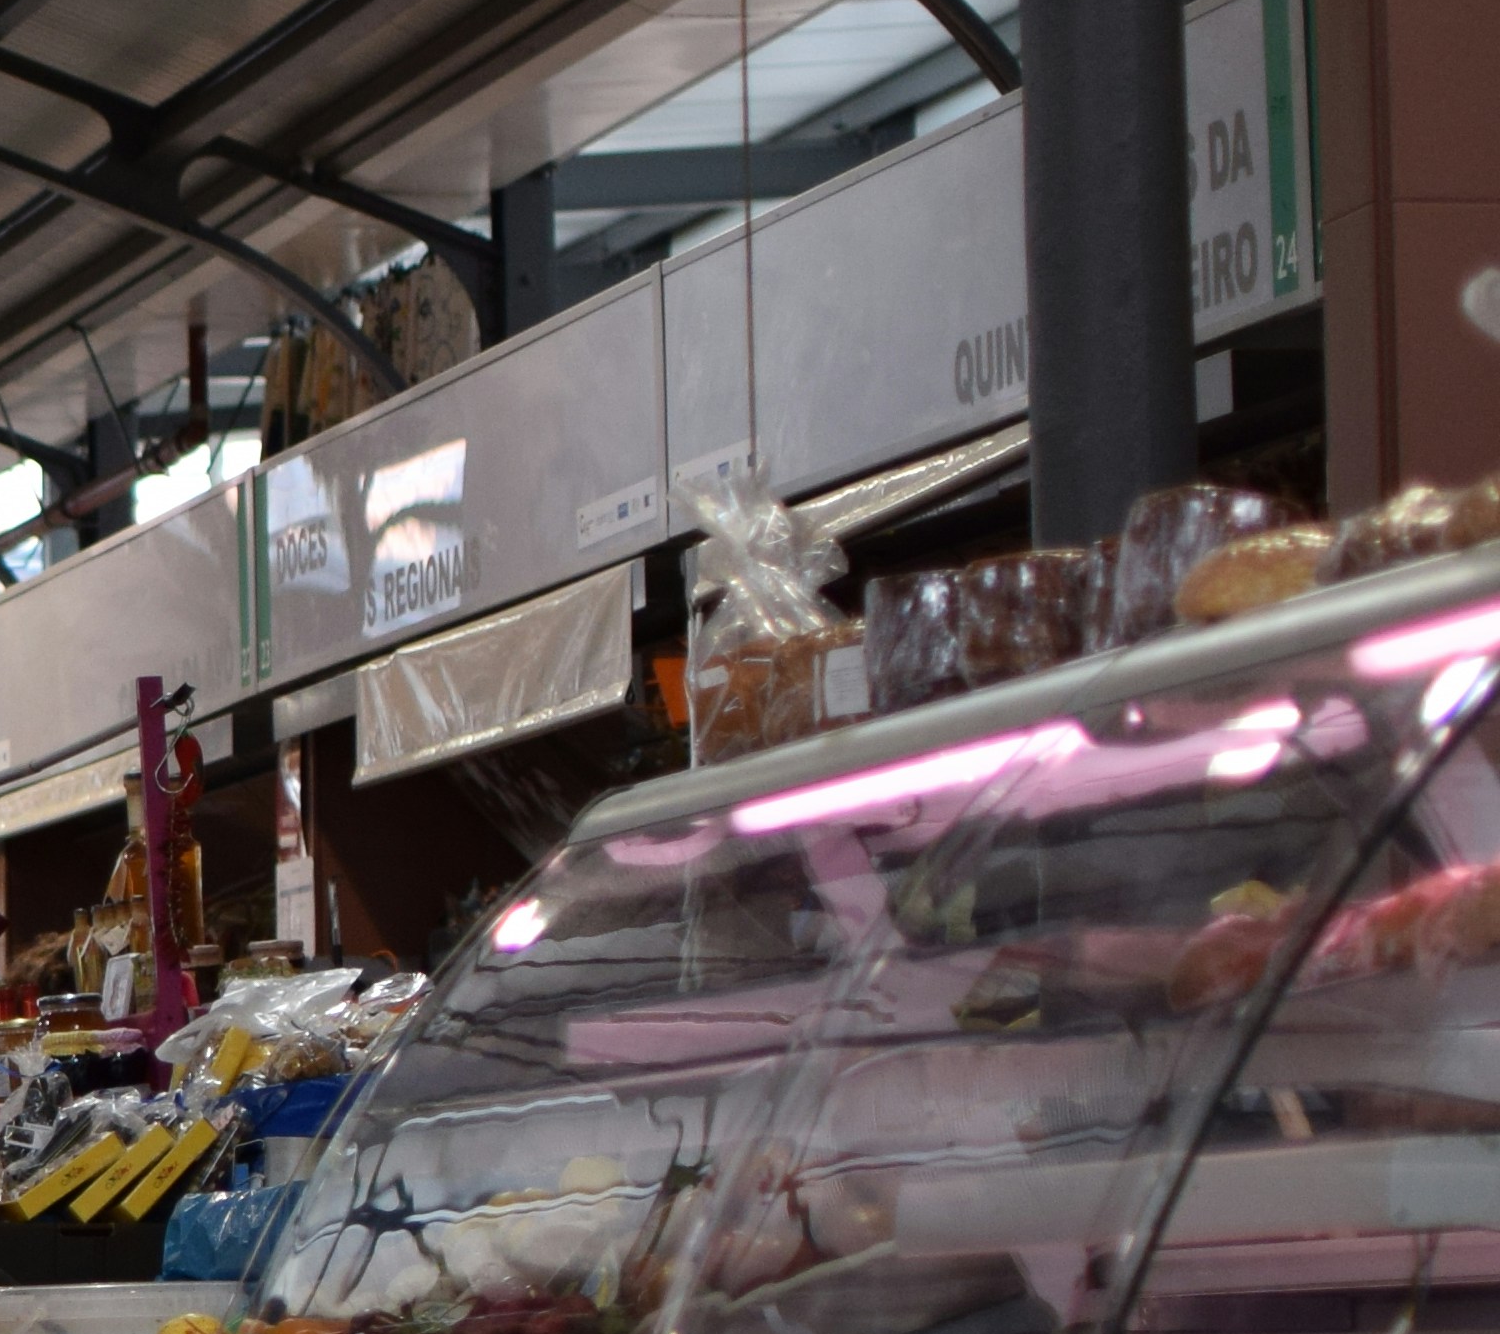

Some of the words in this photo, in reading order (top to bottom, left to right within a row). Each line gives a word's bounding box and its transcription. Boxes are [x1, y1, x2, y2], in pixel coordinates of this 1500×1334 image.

[1208, 108, 1254, 192] DA
[1275, 231, 1299, 280] 24
[955, 314, 1031, 407] QUIN
[275, 519, 328, 584] DOCES
[384, 536, 482, 621] REGIONAIS
